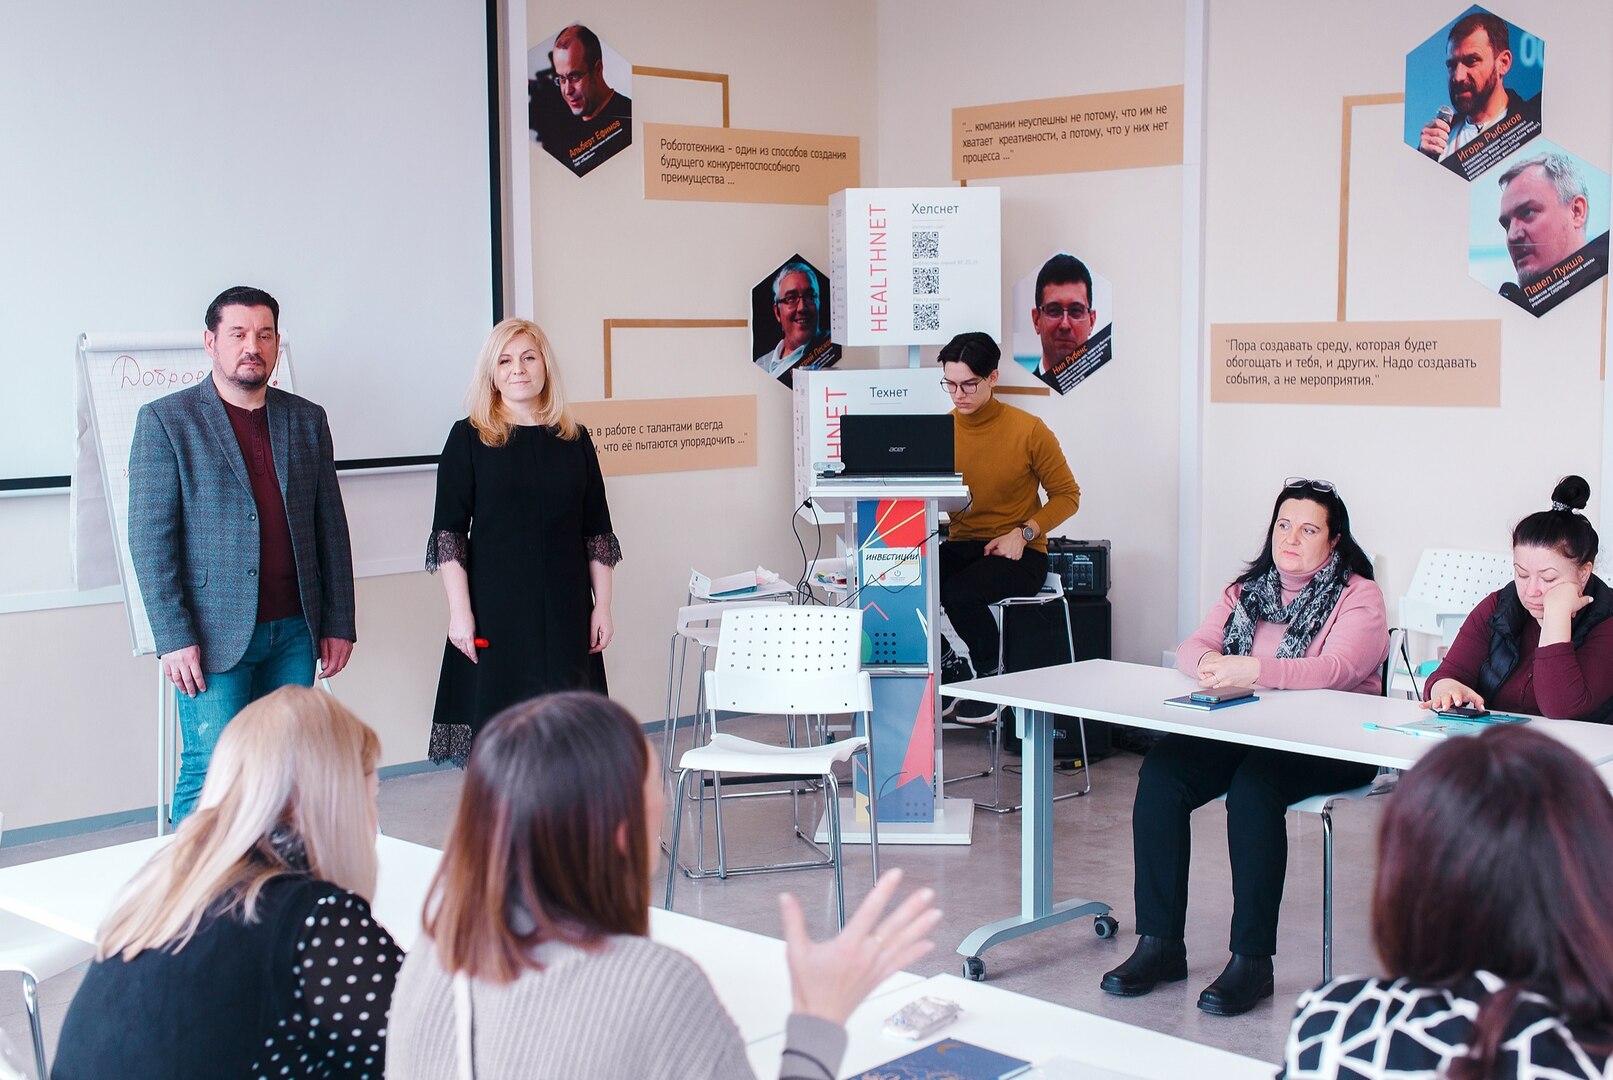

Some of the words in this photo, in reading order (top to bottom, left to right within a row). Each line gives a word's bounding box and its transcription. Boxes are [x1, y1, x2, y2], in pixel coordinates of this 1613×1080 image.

[975, 120, 1015, 132] компании
[1018, 115, 1067, 129] неуспешны
[1071, 114, 1081, 122] не
[1084, 110, 1118, 122] потому,
[1122, 108, 1136, 118] что
[1140, 106, 1152, 115] им
[1156, 104, 1167, 114] не
[569, 137, 594, 158] Альберт
[595, 120, 620, 140] Ефимов
[962, 137, 993, 148] хватает
[998, 132, 1058, 146] креативности,
[1061, 130, 1066, 139] а
[1070, 128, 1104, 139] потому,
[1106, 126, 1122, 136] что
[1124, 124, 1130, 136] у
[1134, 124, 1150, 133] них
[1152, 121, 1168, 131] нет
[1457, 142, 1484, 161] Игорь
[1484, 113, 1522, 142] Рыбаков
[661, 138, 725, 153] Робототехника
[735, 146, 756, 156] один
[760, 147, 768, 156] из
[772, 146, 808, 158] способов
[810, 150, 846, 160] создания
[962, 152, 1000, 164] процесса
[661, 154, 704, 169] будущего
[707, 160, 800, 172] конкурентоспособного
[661, 173, 724, 185] преимущества
[912, 203, 959, 214] Хелснет
[869, 203, 888, 332] HEALTHNET
[1524, 276, 1553, 297] Павел
[1552, 255, 1584, 279] Лукша
[1226, 338, 1256, 353] "Пора
[1260, 342, 1312, 352] создавать
[1316, 341, 1352, 353] среду,
[1356, 340, 1400, 352] которая
[1404, 337, 1438, 353] будет
[1052, 362, 1066, 375] Нил
[1066, 346, 1088, 364] Рубенс
[1226, 355, 1282, 368] обогощать
[1286, 359, 1292, 368] и
[1296, 355, 1322, 368] тебя,
[1326, 359, 1332, 368] и
[1337, 358, 1378, 370] других.
[1383, 356, 1414, 370] Надо
[1418, 358, 1477, 370] создавать
[111, 355, 206, 389] Доброе
[1226, 372, 1270, 385] события,
[1274, 376, 1280, 384] а
[1284, 376, 1296, 385] не
[1300, 374, 1380, 388] мероприятия."
[870, 386, 908, 398] Технет
[596, 428, 601, 436] в
[606, 423, 636, 438] работе
[647, 423, 692, 433] талантами
[695, 420, 723, 431] всегда
[604, 444, 618, 452] что
[622, 440, 632, 451] её
[636, 440, 678, 450] пытаются
[680, 436, 735, 450] упорядочить
